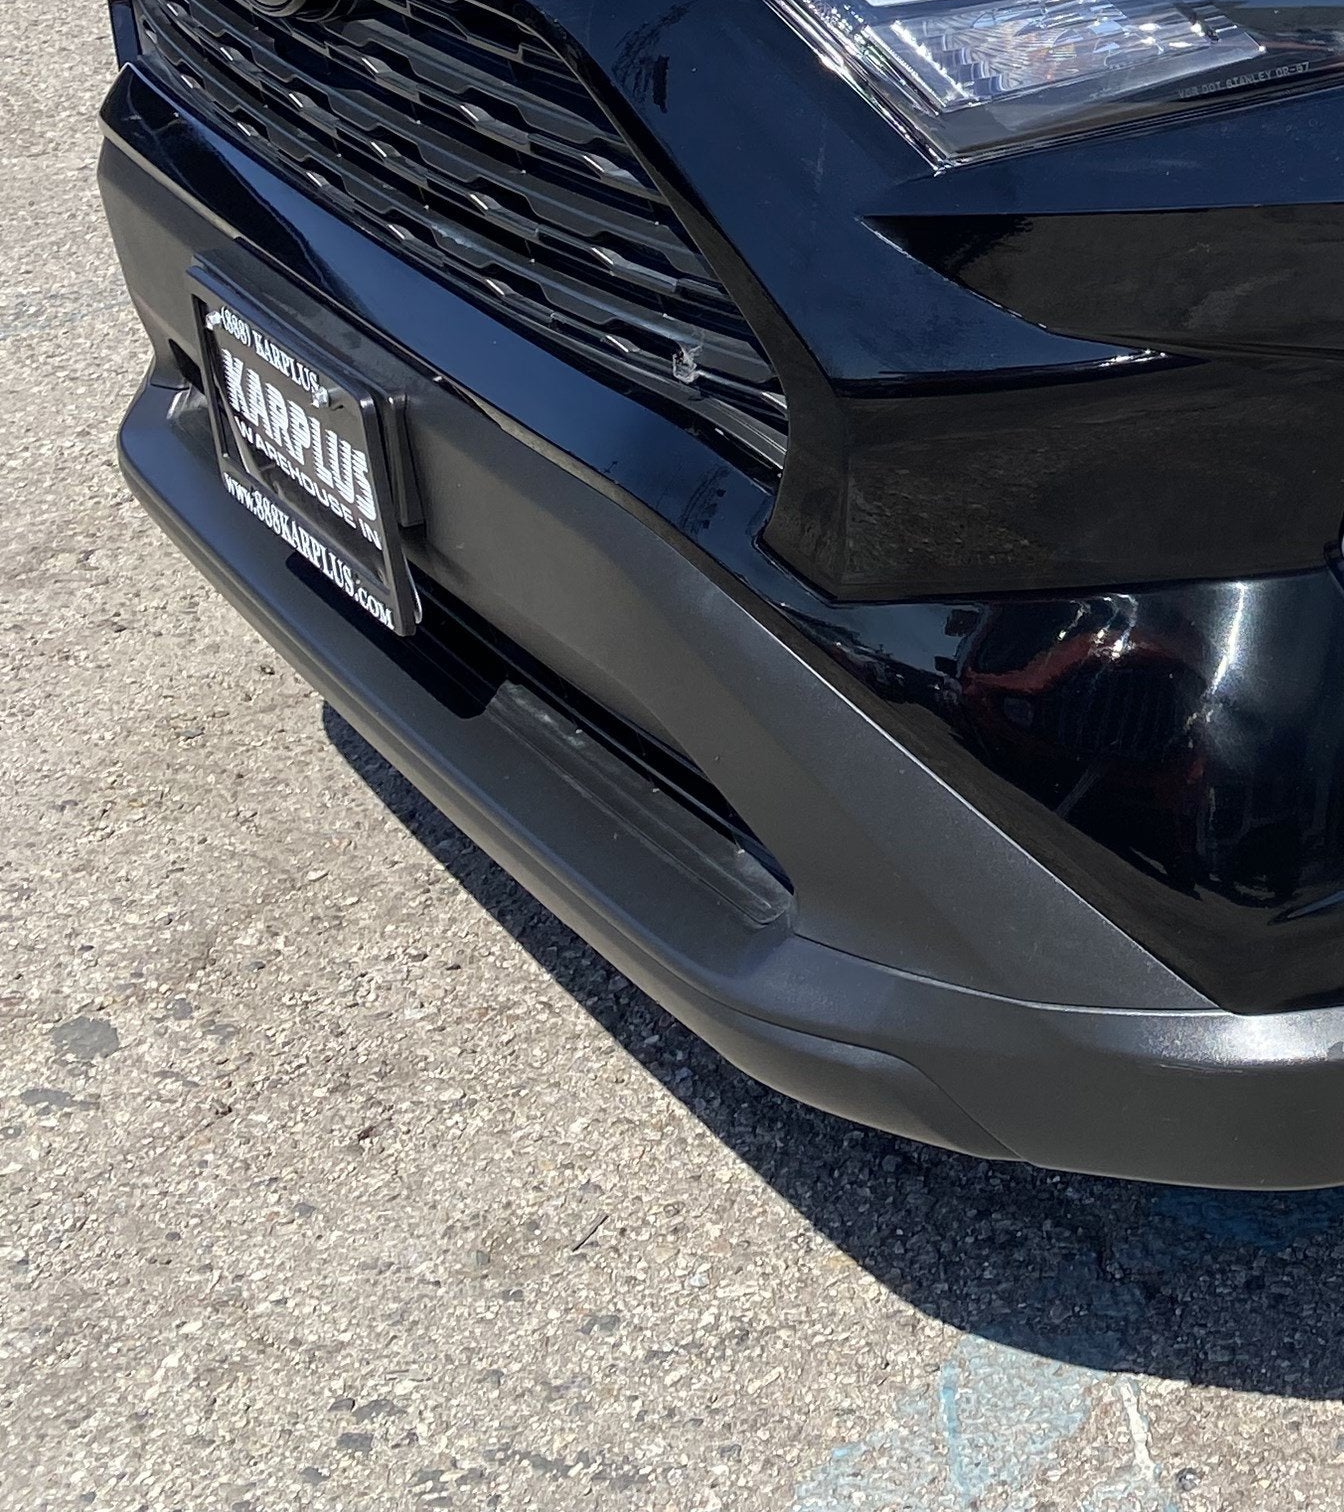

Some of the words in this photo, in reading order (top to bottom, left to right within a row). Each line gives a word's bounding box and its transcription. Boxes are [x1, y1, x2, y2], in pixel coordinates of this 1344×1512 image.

[1226, 69, 1272, 89] STANLEY
[219, 306, 252, 348] (888)
[251, 329, 321, 396] KARPLUS
[221, 348, 377, 522] KARPLUS
[234, 416, 356, 529] WAREHOUSE
[358, 518, 383, 551] IN
